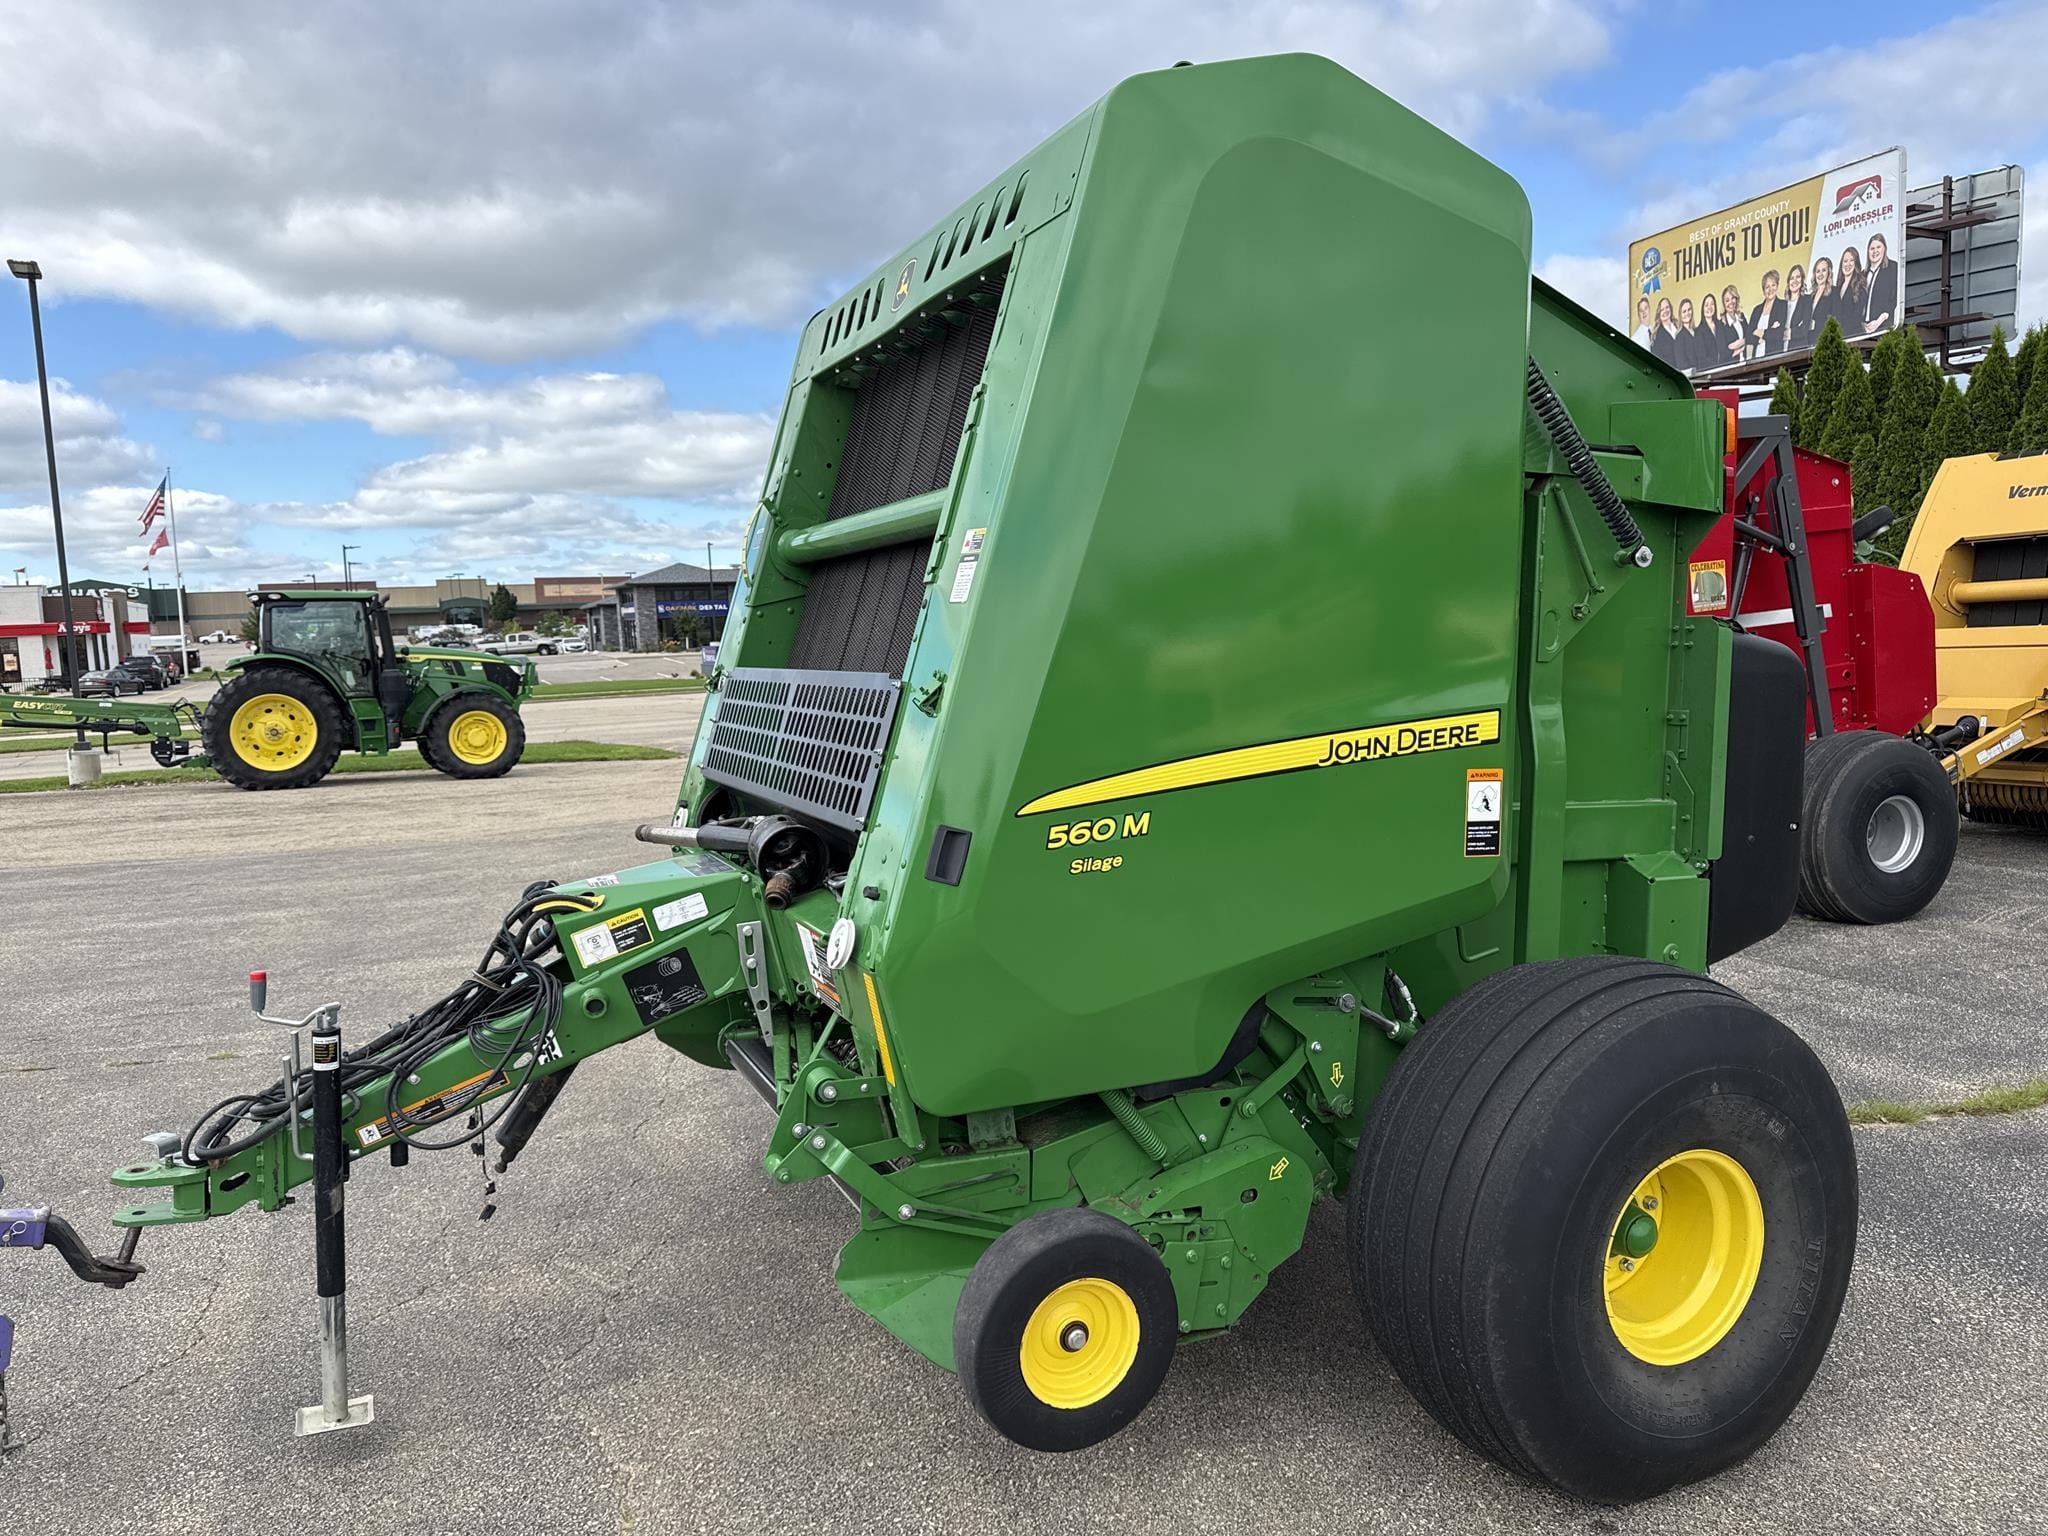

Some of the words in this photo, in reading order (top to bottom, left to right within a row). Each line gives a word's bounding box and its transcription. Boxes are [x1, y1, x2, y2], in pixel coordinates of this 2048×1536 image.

[1689, 228, 1709, 243] BEST
[1711, 222, 1722, 235] OF
[1724, 212, 1752, 232] GRANT
[1754, 199, 1790, 221] COUNTY
[1823, 220, 1842, 233] LORI
[1844, 204, 1893, 227] DROESSLER
[1824, 228, 1846, 238] REAL
[1853, 216, 1886, 230] ESTATE
[1673, 231, 1736, 282] THANKS
[1741, 222, 1762, 261] TO
[1768, 206, 1810, 253] YOU!
[1691, 561, 1724, 572] CELEBRATING
[58, 622, 92, 635] Ay's
[1319, 735, 1390, 764] JOHN
[1398, 723, 1480, 751] DEERE
[1046, 817, 1117, 849] 560
[1122, 811, 1151, 838] M
[1070, 855, 1123, 874] Silage
